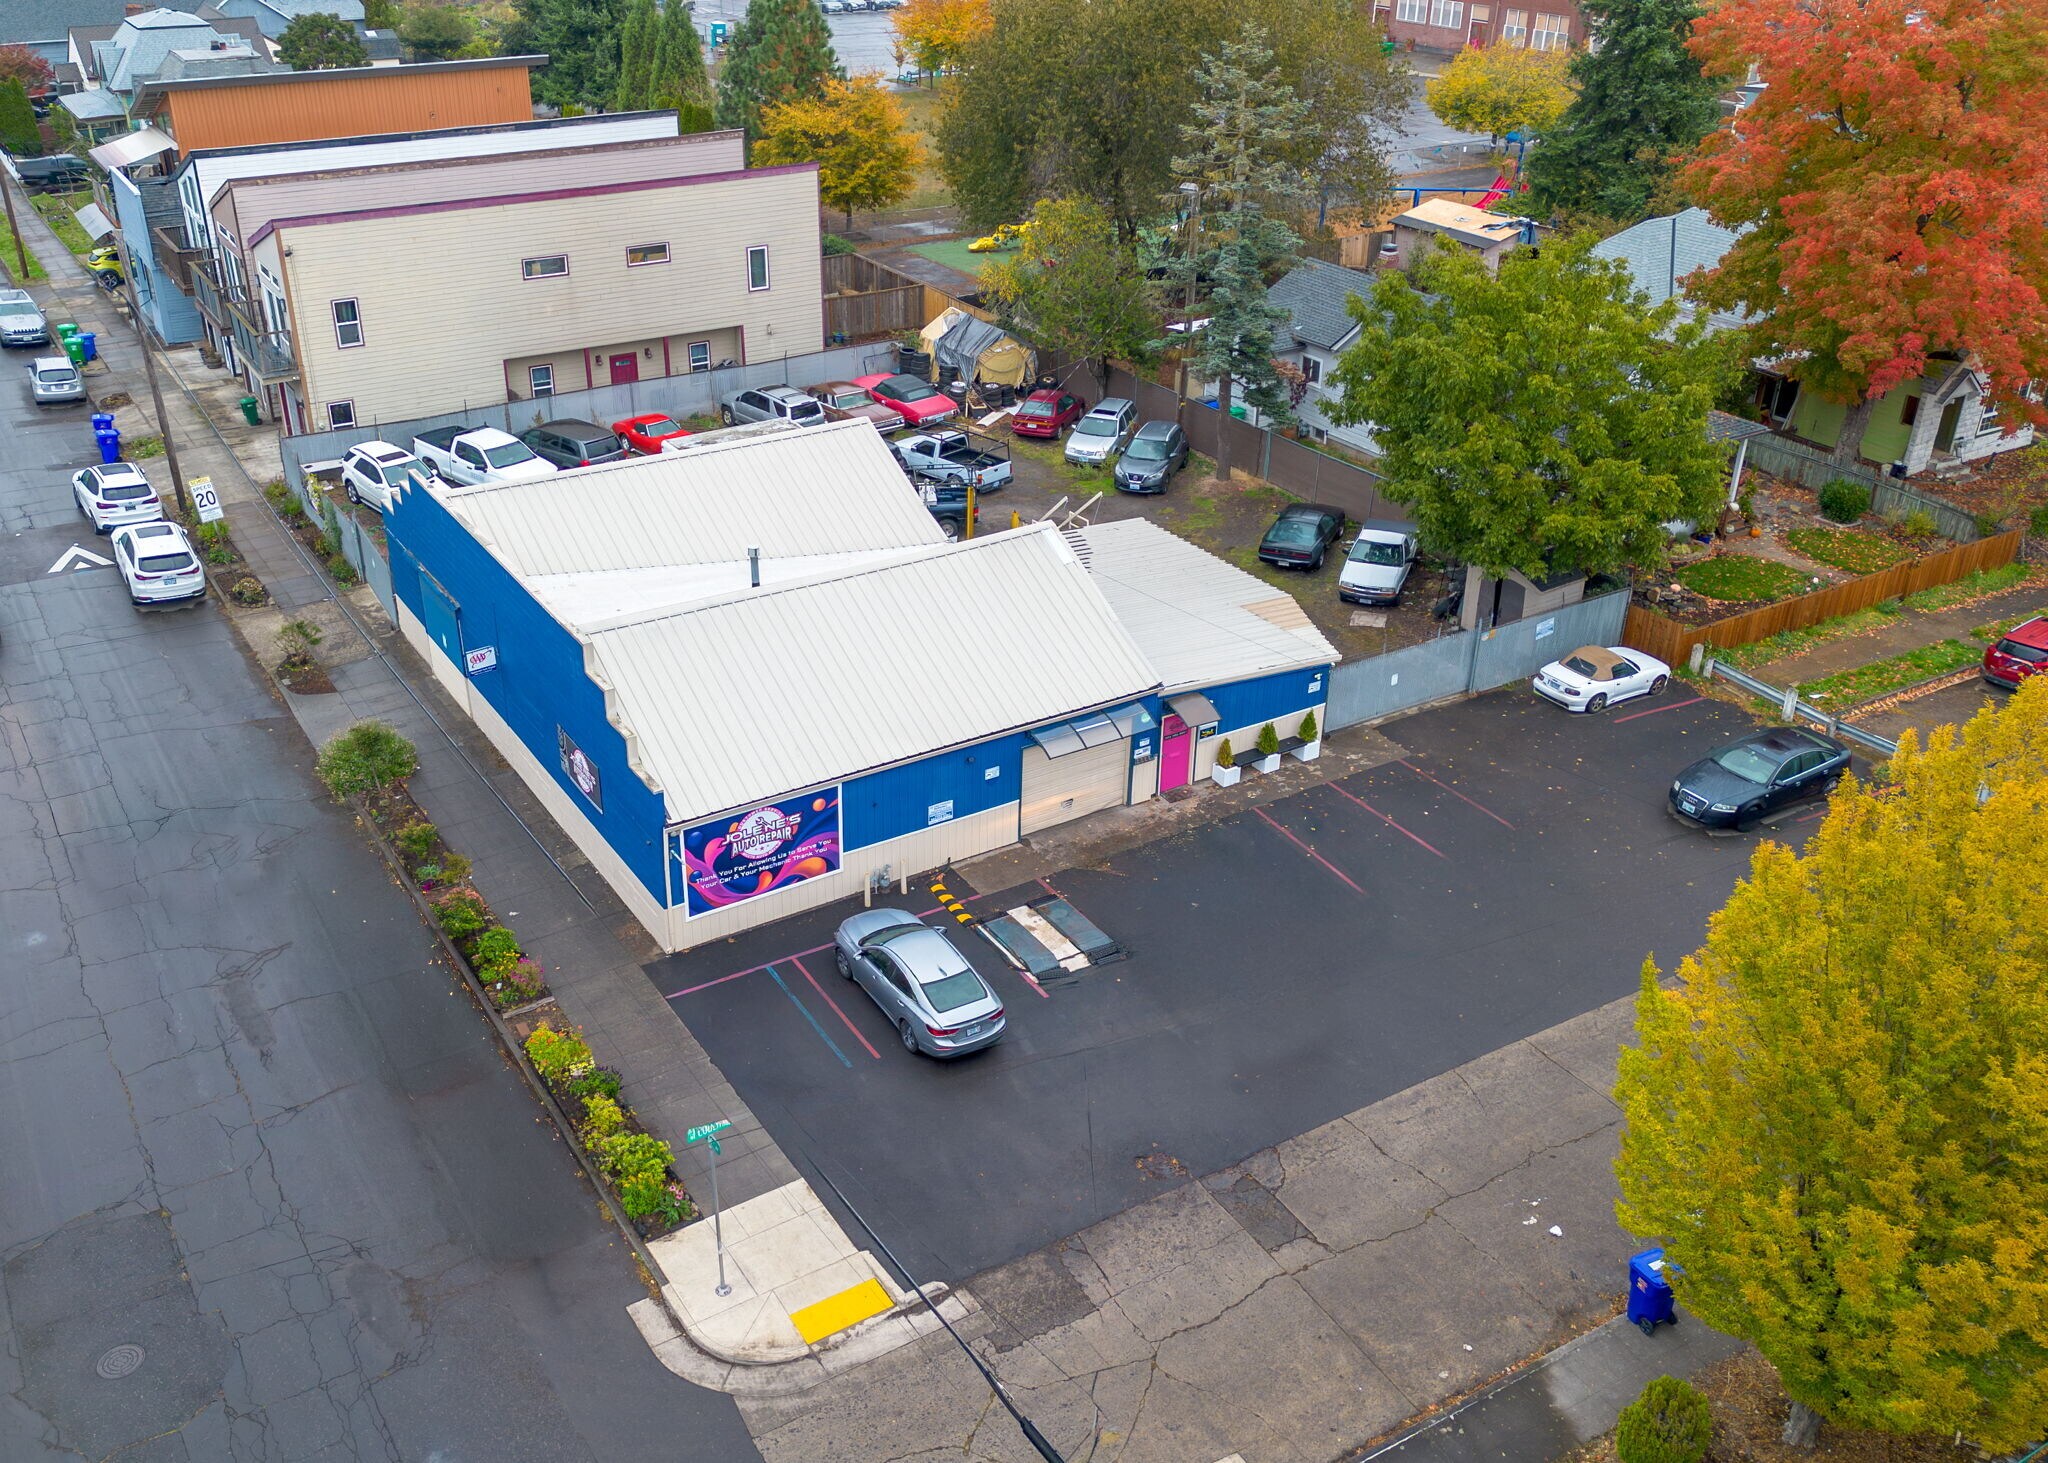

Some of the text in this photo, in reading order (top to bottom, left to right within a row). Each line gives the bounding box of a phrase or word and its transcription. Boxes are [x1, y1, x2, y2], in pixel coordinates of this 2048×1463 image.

[193, 484, 211, 492] SPEED
[196, 491, 216, 508] 20
[722, 812, 801, 846] JOLENE'S
[732, 836, 757, 857] AUTO
[759, 826, 792, 844] REPAIR
[696, 873, 718, 884] Thank
[719, 869, 733, 877] You
[734, 865, 747, 873] For
[748, 855, 777, 868] Allowing
[796, 843, 817, 853] Serve
[818, 839, 832, 847] You
[701, 881, 718, 889] Your
[740, 868, 758, 877] Your
[758, 858, 791, 871] Mechanic
[793, 852, 814, 860] Thank
